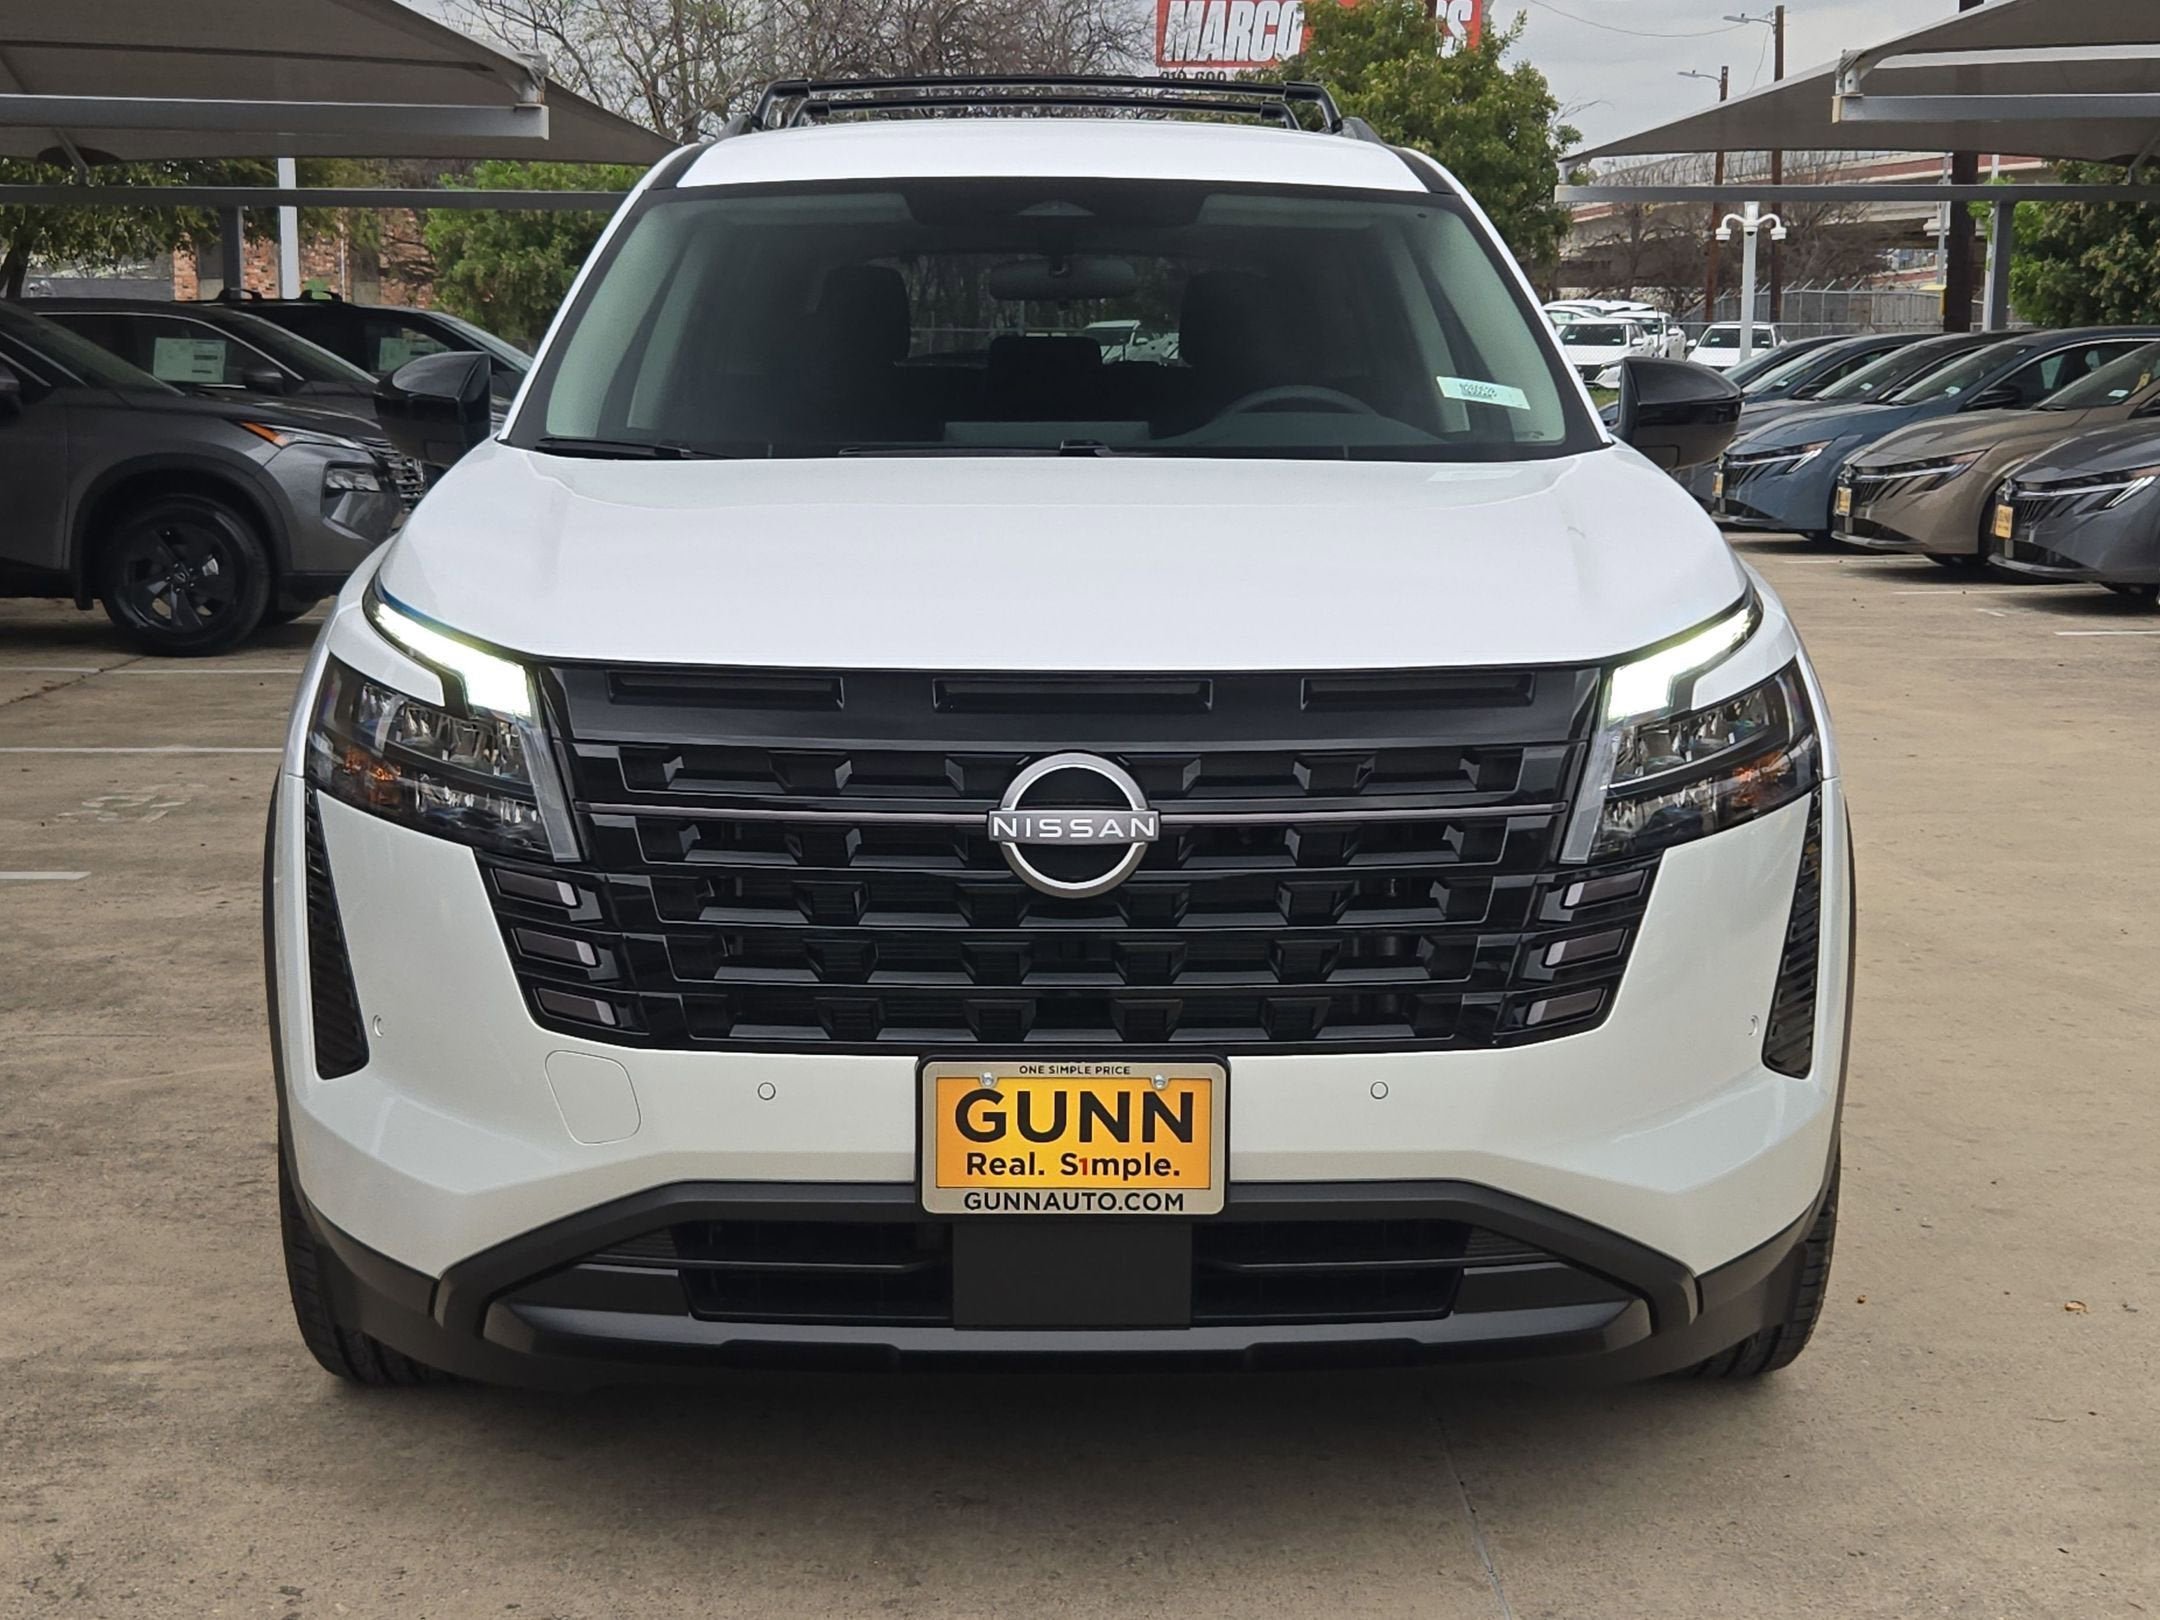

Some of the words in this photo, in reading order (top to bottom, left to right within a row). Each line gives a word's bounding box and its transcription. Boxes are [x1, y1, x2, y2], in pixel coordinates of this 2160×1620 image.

[993, 816, 1154, 838] NISSAN
[1019, 1065, 1045, 1075] ONE
[1048, 1065, 1092, 1075] SIMPLE
[1095, 1066, 1131, 1075] PRICE
[955, 1088, 1194, 1143] GUNN
[966, 1152, 1045, 1176] Real.
[963, 1192, 1184, 1212] GUNNAUTO.COM
